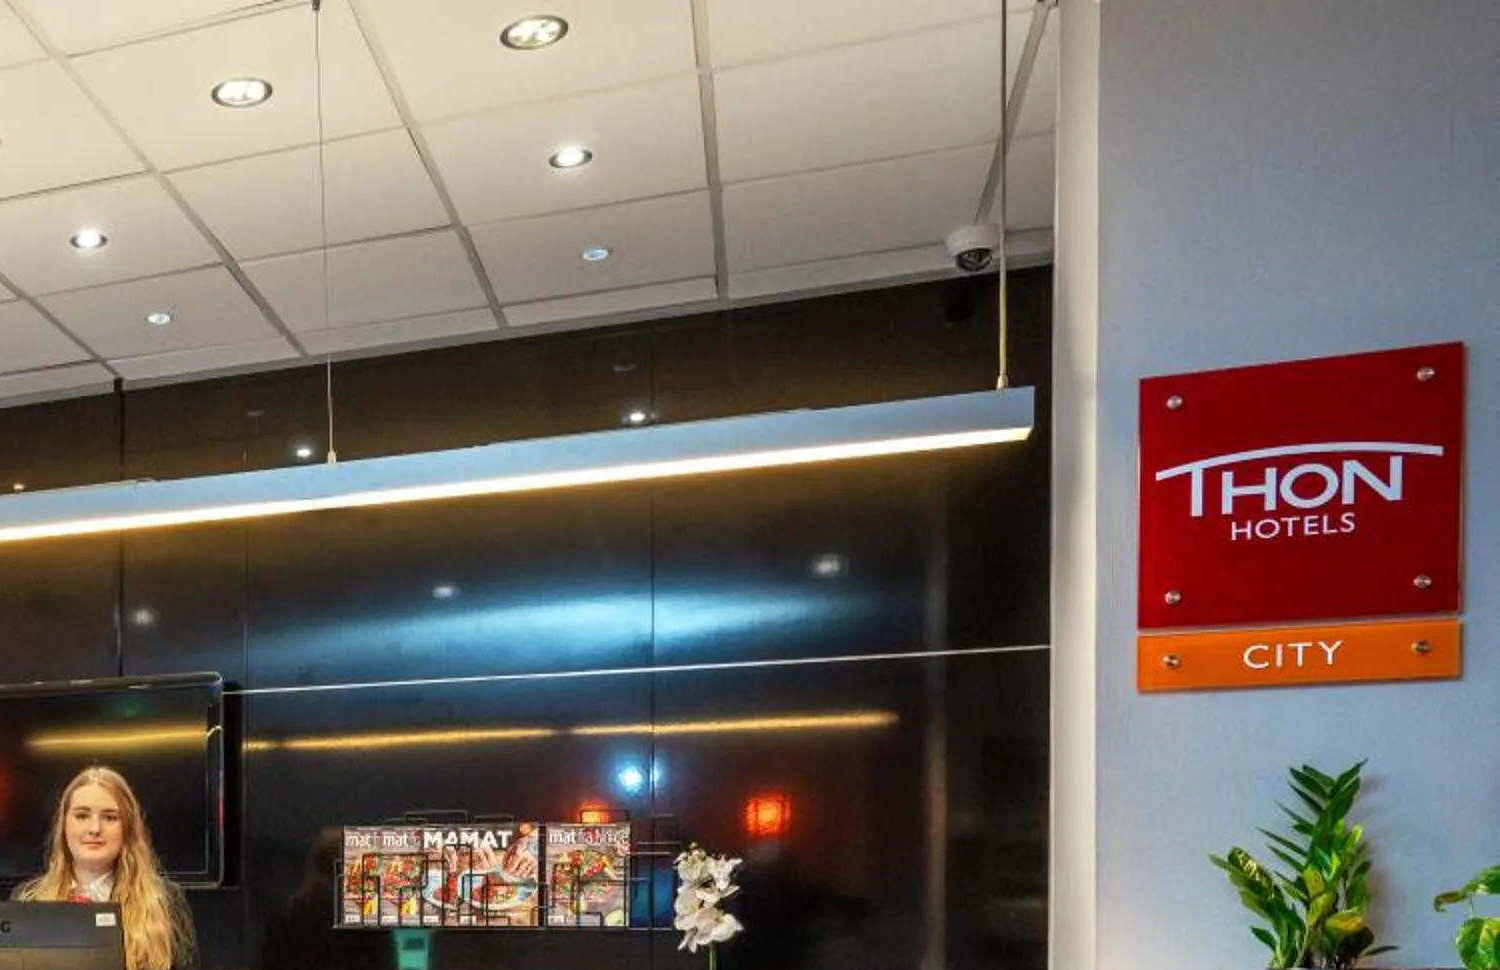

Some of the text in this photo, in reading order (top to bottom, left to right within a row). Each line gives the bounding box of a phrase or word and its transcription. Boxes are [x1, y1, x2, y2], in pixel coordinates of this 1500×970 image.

[1156, 441, 1443, 517] THON
[1231, 512, 1356, 541] HOTELS
[1243, 640, 1343, 669] CITY
[423, 830, 513, 849] MAMAT
